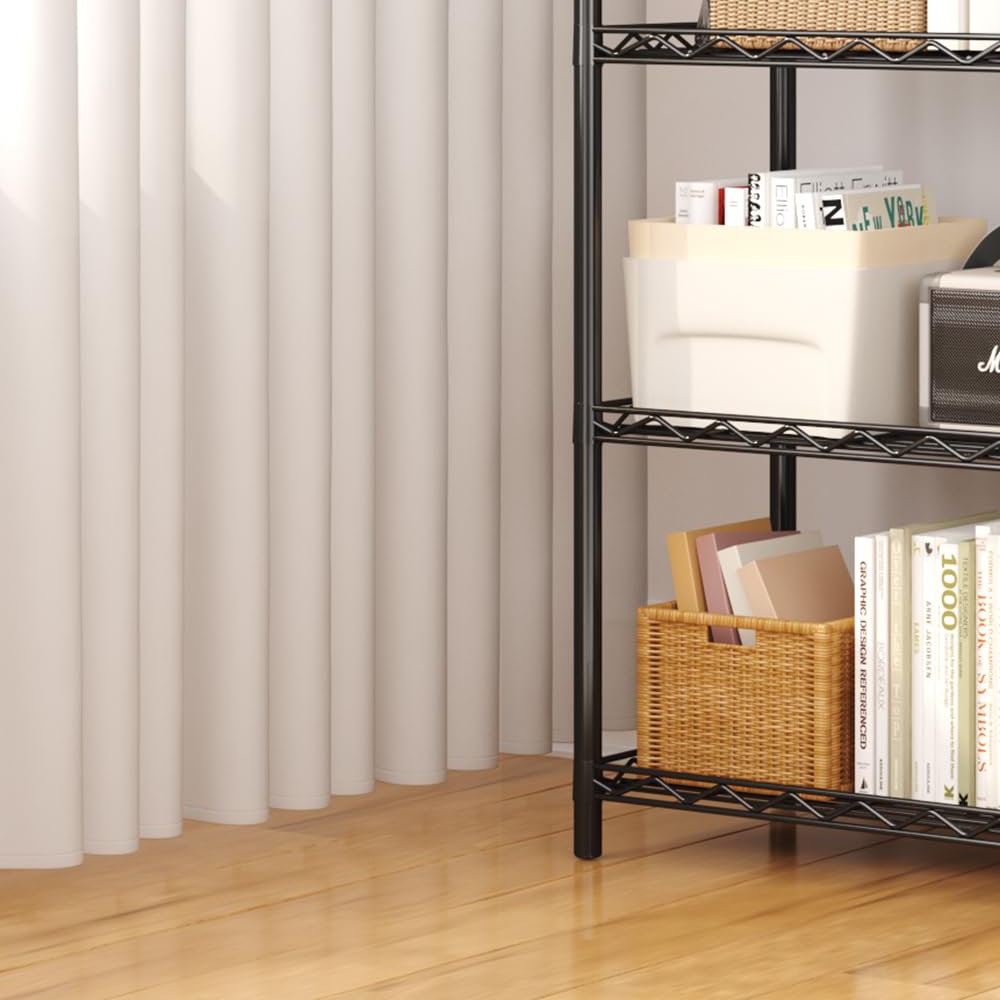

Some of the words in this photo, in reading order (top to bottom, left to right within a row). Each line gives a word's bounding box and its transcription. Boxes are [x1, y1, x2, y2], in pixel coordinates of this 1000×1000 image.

[884, 195, 924, 229] YORK
[942, 554, 957, 630] 1000
[978, 595, 986, 649] BOOK
[978, 673, 986, 772] SYMBOLS
